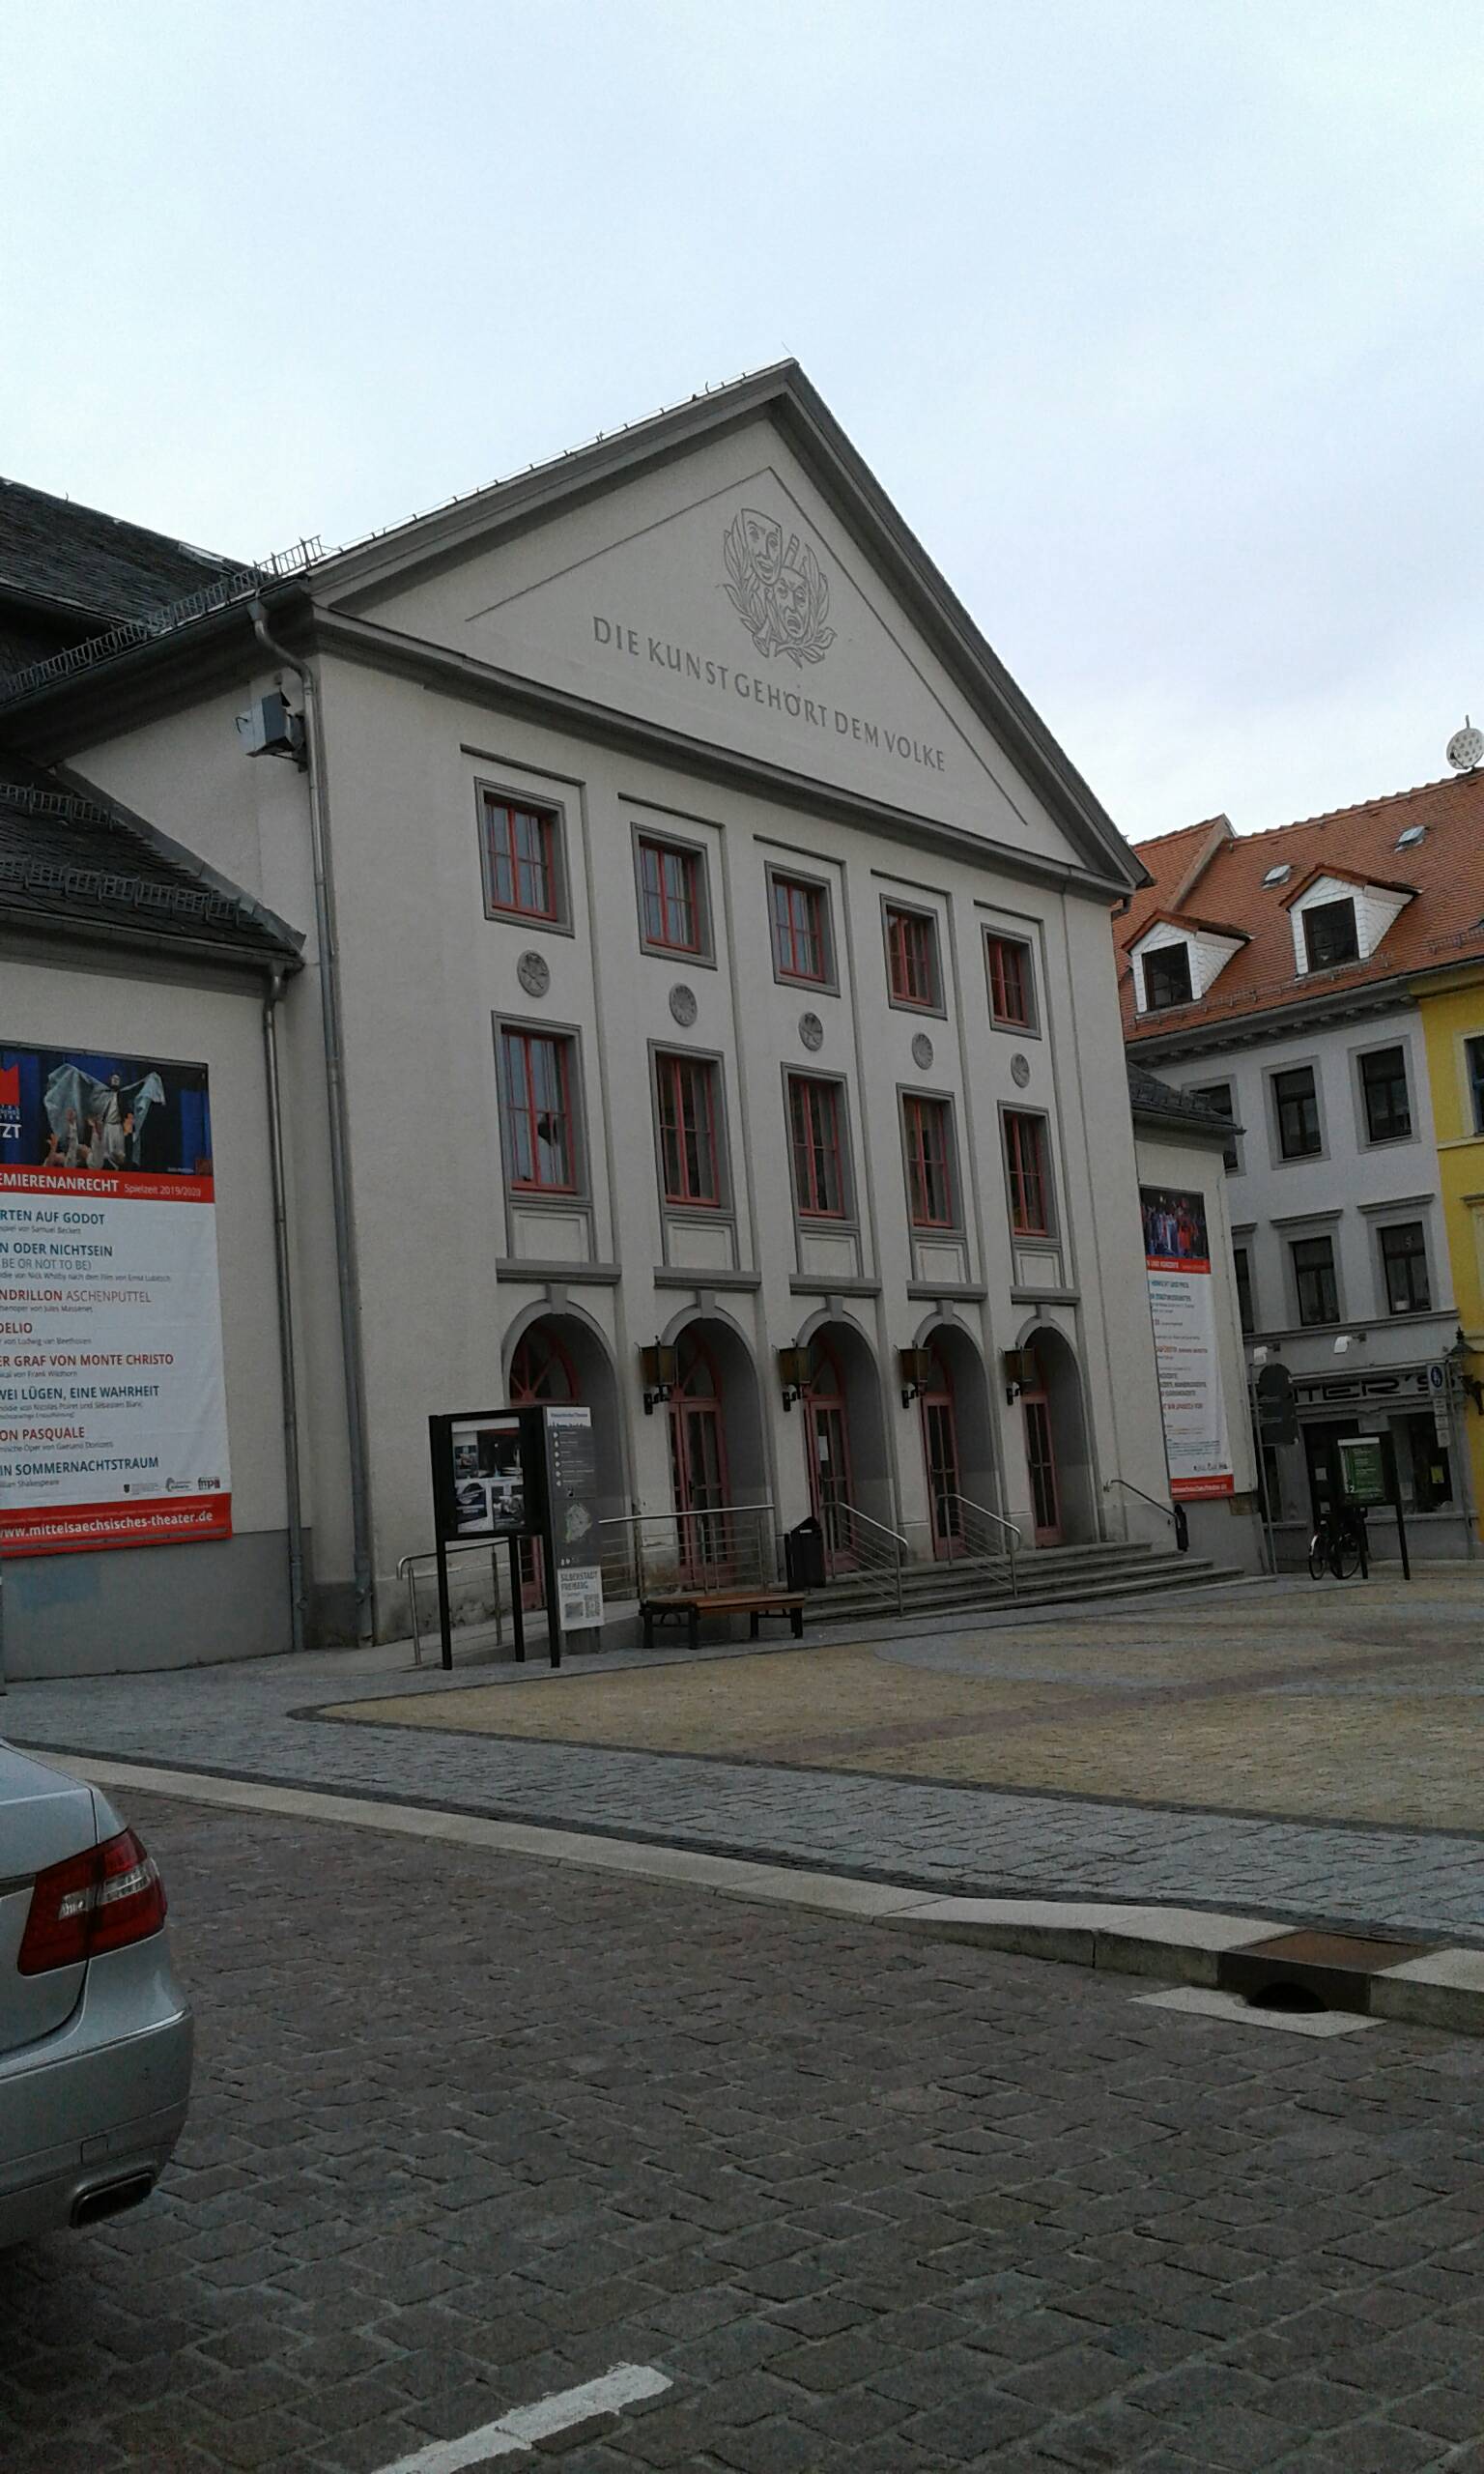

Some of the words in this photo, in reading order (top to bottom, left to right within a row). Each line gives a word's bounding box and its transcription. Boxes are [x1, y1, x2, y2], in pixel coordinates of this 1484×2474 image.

[593, 616, 640, 656] DIE
[647, 637, 728, 690] KUNST
[734, 673, 827, 727] GEHÖRT
[835, 710, 879, 748] DEM
[884, 730, 945, 772] VOLKE
[0, 1122, 21, 1138] ZT
[125, 1183, 158, 1196] Spielzeit
[36, 1211, 60, 1223] AUF
[63, 1212, 105, 1225] GODOT
[14, 1243, 46, 1254] ODER
[50, 1244, 113, 1257] NICHTSEIN
[2, 1258, 15, 1269] BE
[17, 1258, 33, 1269] OR
[35, 1259, 57, 1270] NOT
[59, 1259, 72, 1270] TO
[75, 1260, 92, 1271] BE)
[66, 1290, 152, 1304] ASCHENPUTTEL
[14, 1355, 46, 1367] GRAF
[49, 1354, 76, 1366] VON
[80, 1354, 123, 1366] MONTE
[126, 1353, 174, 1366] CHRISTO
[21, 1385, 67, 1401] LÜGEN,
[71, 1386, 97, 1399] EINE
[100, 1385, 159, 1398] WAHRHEIT
[22, 1426, 85, 1442] PASQUALE
[15, 1456, 158, 1476] SOMMERNACHTSTRAUM
